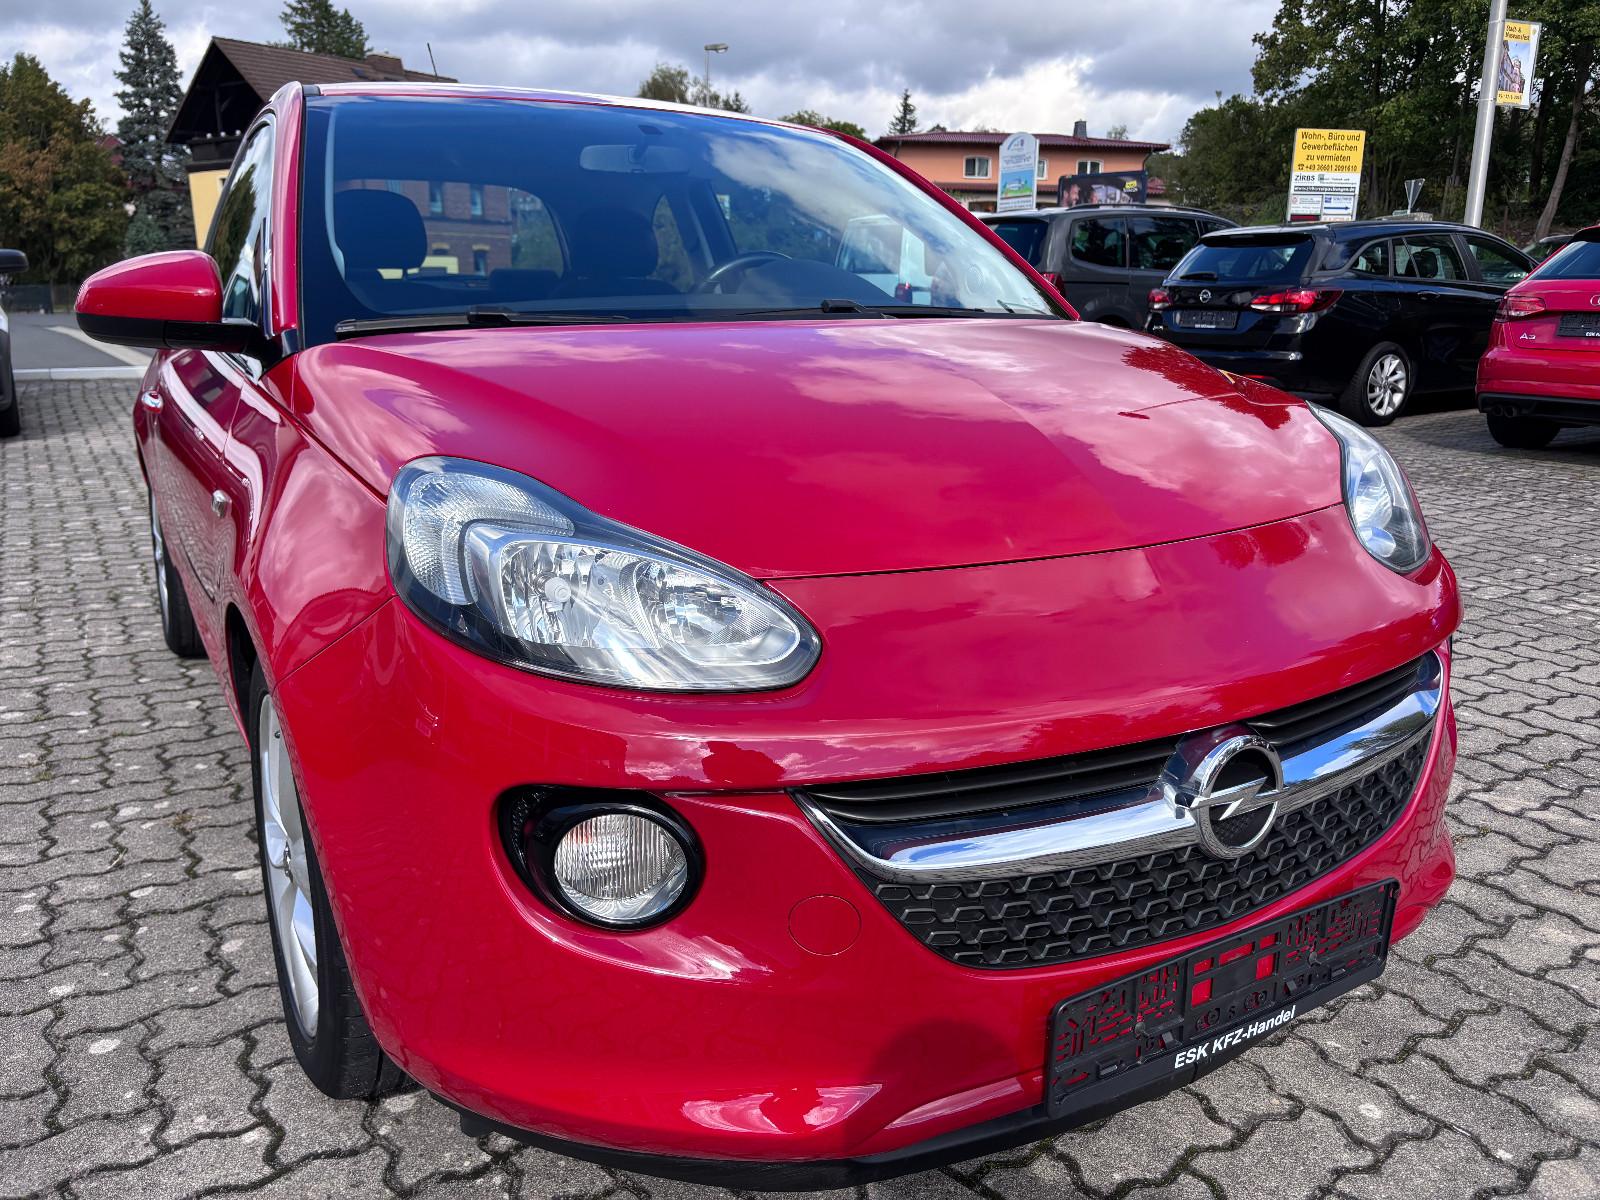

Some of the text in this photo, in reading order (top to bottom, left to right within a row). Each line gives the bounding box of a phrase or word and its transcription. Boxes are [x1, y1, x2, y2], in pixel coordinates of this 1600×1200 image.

[1301, 131, 1361, 141] Wohn-, Büro und
[1301, 142, 1358, 151] Gewerbeflächen
[1316, 154, 1351, 162] vermieten
[1174, 1004, 1297, 1069] ESK KFZ-Handel
